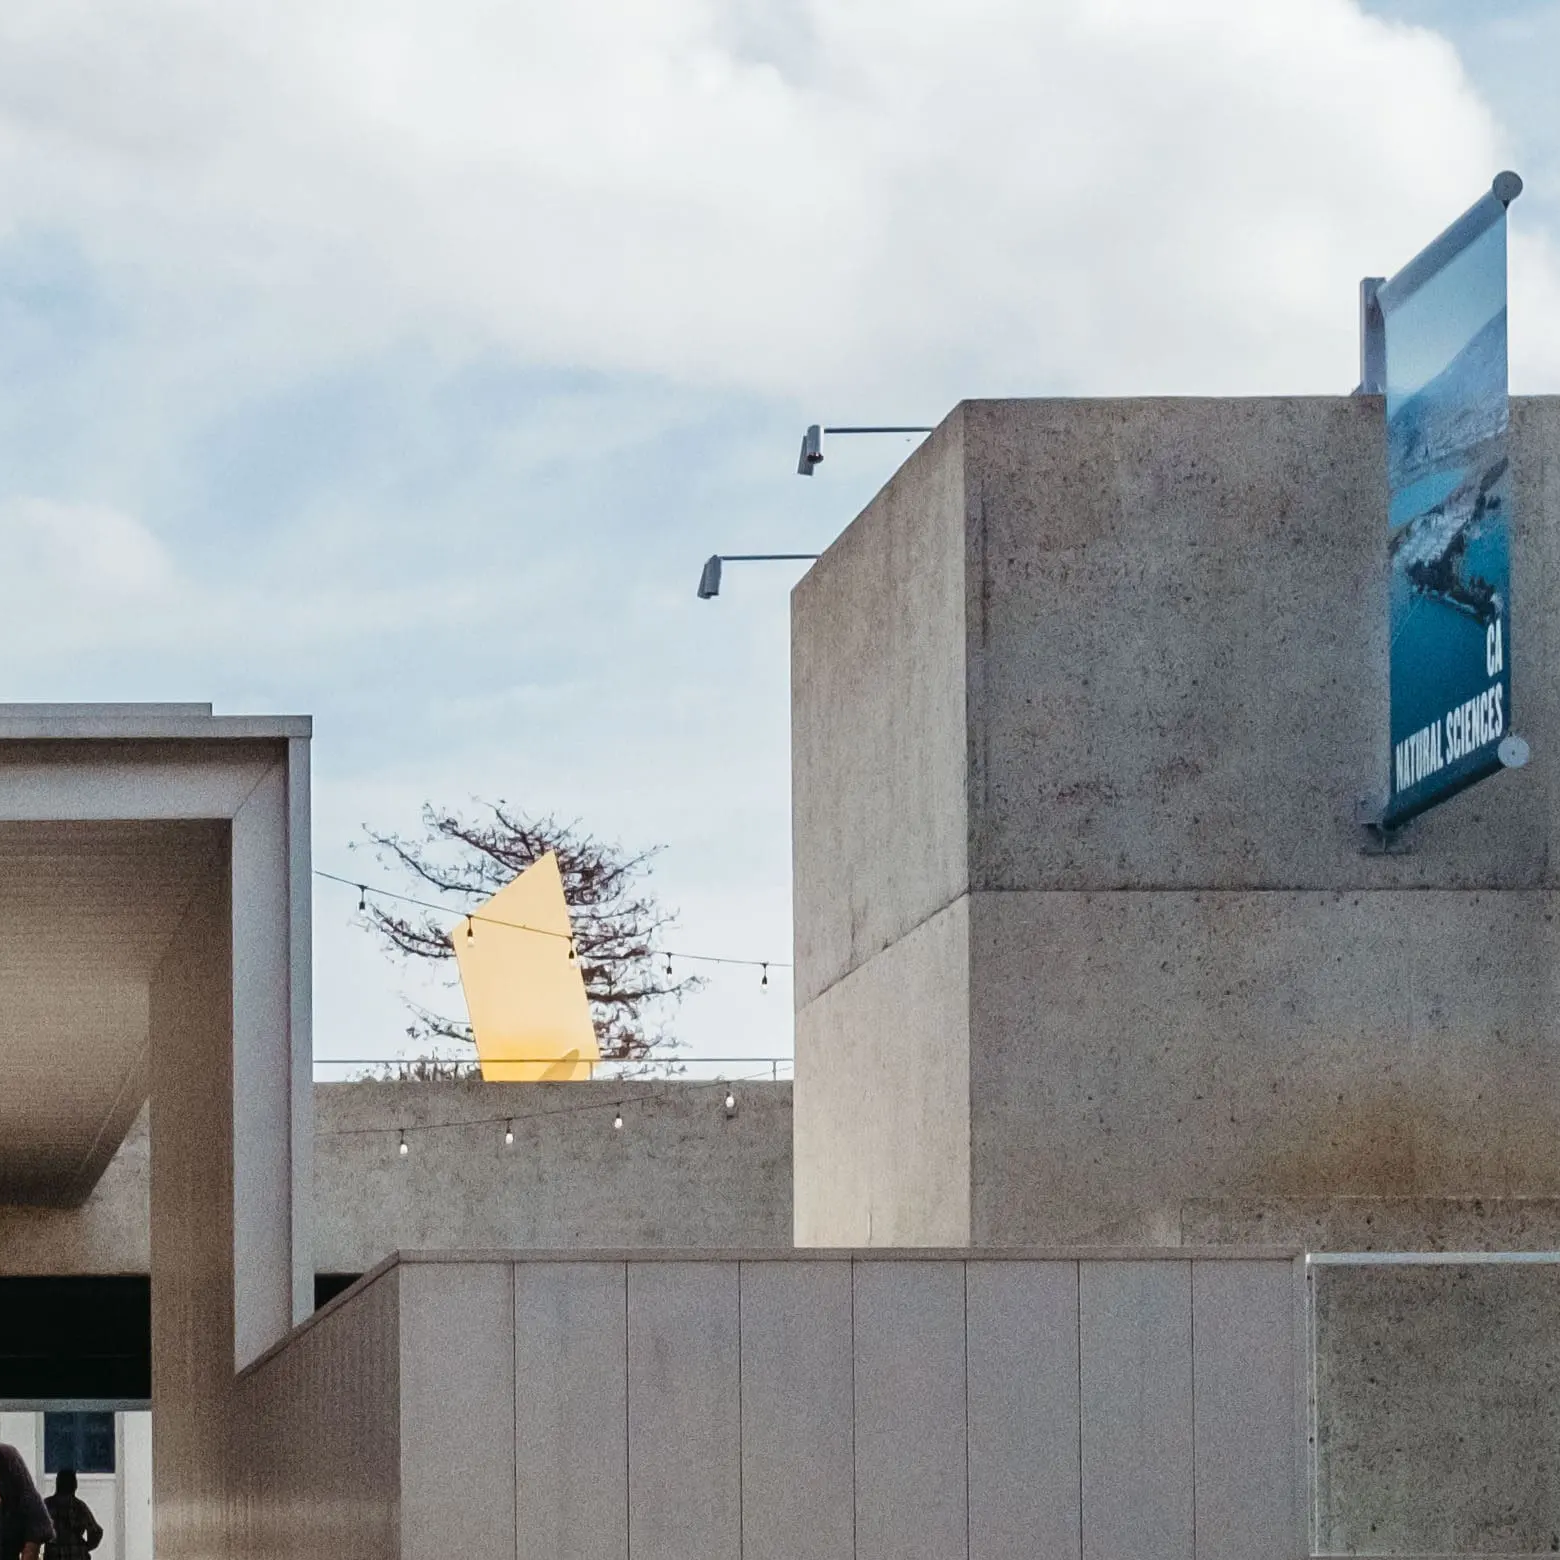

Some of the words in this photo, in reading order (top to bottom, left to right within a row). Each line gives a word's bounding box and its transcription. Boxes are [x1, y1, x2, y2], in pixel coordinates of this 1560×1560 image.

[1486, 617, 1503, 678] CA
[1395, 719, 1444, 794] NATURAL
[1445, 681, 1503, 766] SCIENCES
